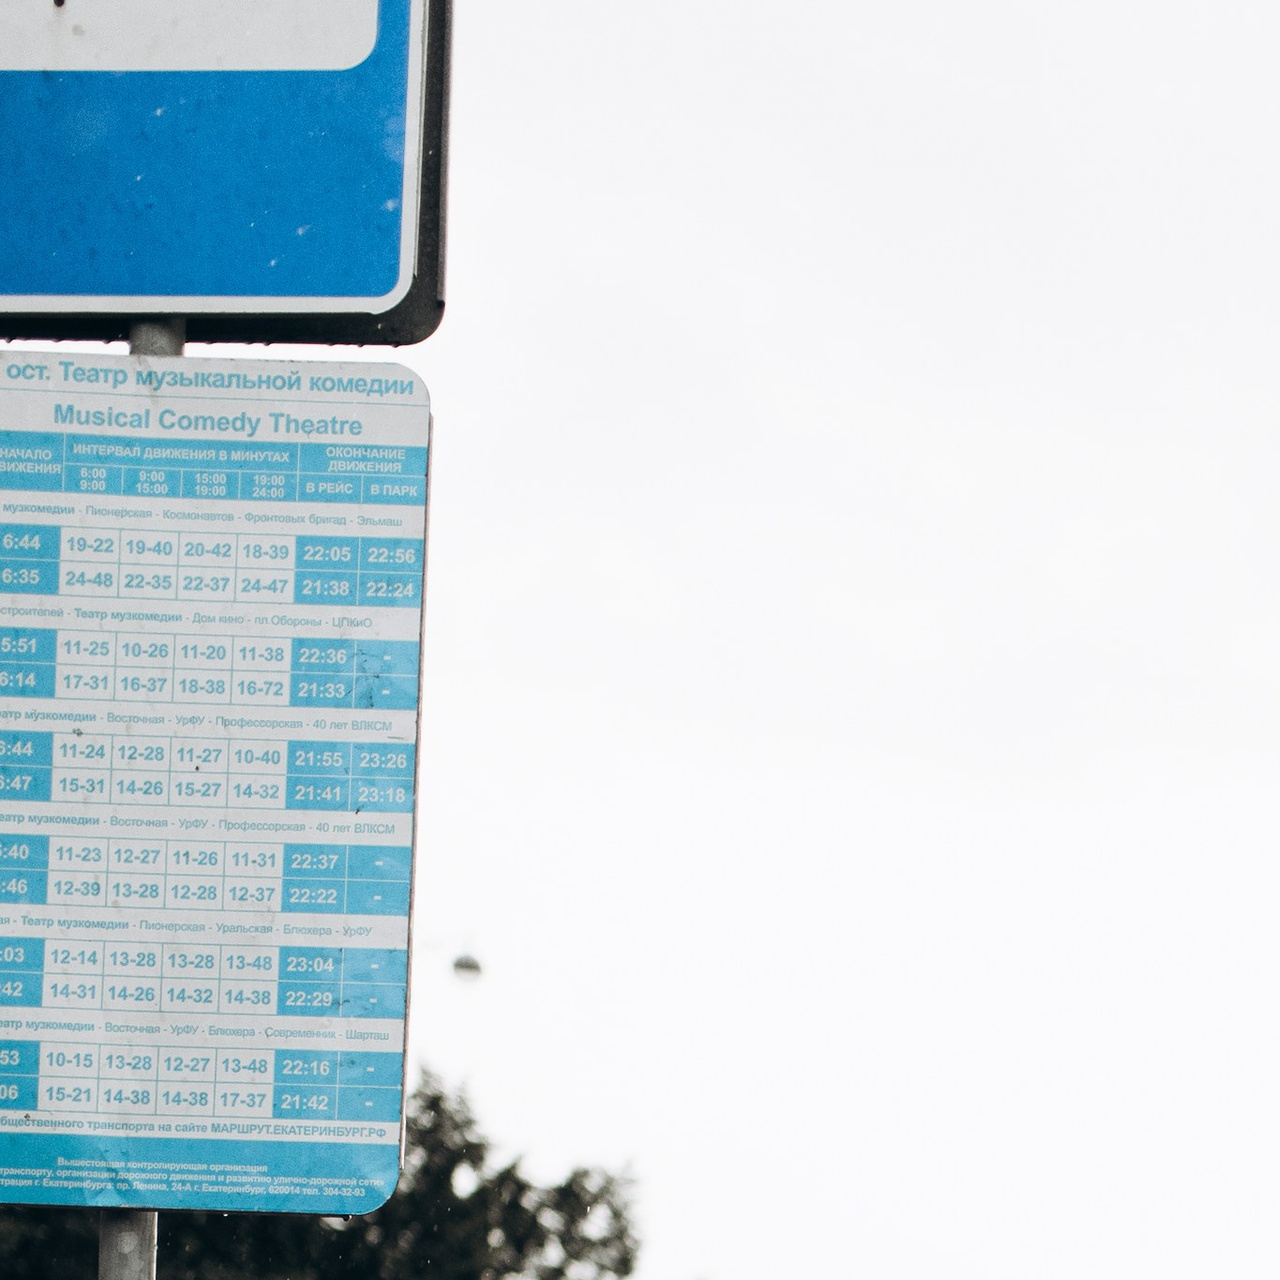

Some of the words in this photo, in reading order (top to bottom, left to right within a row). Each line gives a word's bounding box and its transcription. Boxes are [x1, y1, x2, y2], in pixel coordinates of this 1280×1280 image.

[6, 363, 50, 380] ост.
[59, 361, 128, 388] Театр
[136, 370, 301, 391] музыкальной
[309, 375, 414, 397] комедии
[54, 404, 150, 429] Musical
[158, 409, 261, 437] Comedy
[269, 413, 363, 435] Theatre
[73, 443, 140, 456] ИНТЕРВАЛ
[143, 447, 215, 460] ДВИЖЕНИЯ
[220, 450, 228, 460] В
[231, 451, 289, 462] МИНУТАХ
[326, 446, 406, 459] ОКОНЧАНИЕ
[0, 462, 61, 474] ВИЖЕНИЯ
[80, 468, 106, 478] 6:00
[139, 471, 165, 482] 9:00
[195, 473, 227, 484] 15:00
[253, 475, 285, 485] 19:00
[328, 461, 402, 472] ДВИЖЕНИЯ
[80, 480, 105, 490] 9:00
[136, 484, 168, 494] 15:00
[195, 485, 226, 496] 19:00
[252, 487, 284, 498] 24:00
[306, 483, 315, 493] В
[318, 481, 353, 494] РЕЙС
[370, 485, 379, 494] В
[383, 485, 417, 496] ПАРК
[3, 504, 75, 515] музкомедии
[85, 505, 152, 519] Пионерская
[162, 509, 234, 521] Космонавтов
[245, 512, 305, 525] Фронтовых
[309, 514, 347, 525] бригад
[357, 515, 402, 527] Эльмаш
[3, 533, 41, 550] 6:44
[67, 537, 114, 553] 19-22
[126, 539, 173, 556] 19-40
[184, 542, 231, 557] 20-42
[243, 544, 289, 559] 18-39
[303, 546, 350, 562] 22:05
[367, 548, 415, 563] 22:56
[1, 568, 40, 584] 6:35
[65, 571, 113, 587] 24-48
[124, 574, 172, 590] 22-35
[182, 576, 230, 592] 22-37
[241, 578, 288, 593] 24-47
[302, 579, 349, 595] 21:38
[366, 582, 413, 597] 22:24
[0, 607, 64, 618] строителей
[74, 608, 107, 621] Театр
[111, 610, 182, 623] музкомедии
[192, 613, 216, 624] Дом
[219, 615, 244, 624] кино
[254, 615, 322, 627] пл.Обороны
[332, 617, 372, 628] ЦПКиО
[1, 637, 37, 653] 5:51
[64, 640, 110, 656] 11-25
[122, 642, 169, 658] 10-26
[181, 645, 226, 660] 11-20
[239, 646, 284, 662] 11-38
[299, 648, 347, 664] 22:36
[0, 672, 35, 687] 6:14
[63, 674, 109, 690] 17-31
[120, 676, 167, 693] 16-37
[179, 679, 225, 694] 18-38
[237, 681, 283, 696] 16-72
[298, 682, 345, 698] 21:33
[25, 711, 96, 722] музкомедии
[107, 713, 164, 724] Восточная
[175, 715, 205, 726] УрФУ
[216, 716, 303, 729] Профессорская
[312, 720, 327, 729] 40
[329, 722, 348, 730] лет
[351, 720, 392, 731] ВЛКСМ
[60, 743, 105, 759] 11-24
[118, 745, 164, 761] 12-28
[177, 747, 222, 763] 11-27
[235, 749, 281, 765] 10-40
[295, 751, 343, 767] 21:55
[359, 753, 407, 768] 23:26
[59, 777, 105, 794] 15-31
[116, 780, 163, 795] 14-26
[175, 782, 221, 797] 15-27
[233, 783, 279, 799] 14-32
[295, 785, 341, 801] 21:41
[358, 787, 405, 803] 23:18
[28, 815, 100, 826] музкомедии
[110, 816, 168, 827] Восточная
[179, 818, 208, 829] УрФУ
[219, 819, 305, 832] Профессорская
[315, 823, 329, 832] 40
[332, 825, 351, 833] лет
[354, 823, 395, 834] ВЛКСМ
[56, 846, 102, 862] 11-23
[114, 848, 160, 864] 12-27
[173, 851, 218, 866] 11-26
[232, 852, 276, 868] 11-31
[291, 854, 339, 869] 22:37
[54, 880, 100, 896] 12-39
[113, 882, 159, 898] 13-28
[171, 885, 216, 900] 12-28
[229, 886, 275, 902] 12-37
[290, 888, 337, 904] 22:22
[21, 915, 54, 927] Театр
[57, 919, 129, 930] музкомедии
[139, 920, 205, 933] Пионерская
[216, 923, 272, 934] Уральская
[283, 924, 332, 936] Блюхера
[342, 926, 372, 937] УрФУ
[51, 949, 98, 965] 12-14
[110, 951, 156, 967] 13-28
[169, 953, 214, 969] 13-28
[226, 955, 272, 971] 13-48
[286, 956, 334, 972] 23:04
[50, 984, 96, 999] 14-31
[108, 986, 155, 1001] 14-26
[167, 988, 213, 1003] 14-32
[225, 989, 271, 1005] 14-38
[285, 991, 332, 1007] 22:29
[25, 1020, 95, 1031] музкомедии
[104, 1022, 160, 1034] Восточная
[170, 1024, 199, 1035] УрФУ
[208, 1025, 255, 1037] Блюхера
[265, 1027, 336, 1039] Современник
[346, 1030, 389, 1040] Шарташ
[46, 1052, 93, 1068] 10-15
[105, 1054, 152, 1071] 13-28
[163, 1057, 210, 1072] 12-27
[221, 1058, 268, 1074] 13-48
[282, 1059, 330, 1075] 22:16
[46, 1087, 91, 1102] 15-21
[104, 1089, 150, 1104] 14-38
[162, 1090, 209, 1107] 14-38
[220, 1092, 266, 1108] 17-37
[281, 1094, 328, 1110] 21:42
[0, 1116, 84, 1128] бщественного
[87, 1120, 156, 1133] транспорта
[211, 1122, 386, 1138] МАРШРУТ.ЕКАТЕРИНБУРГ.РФ
